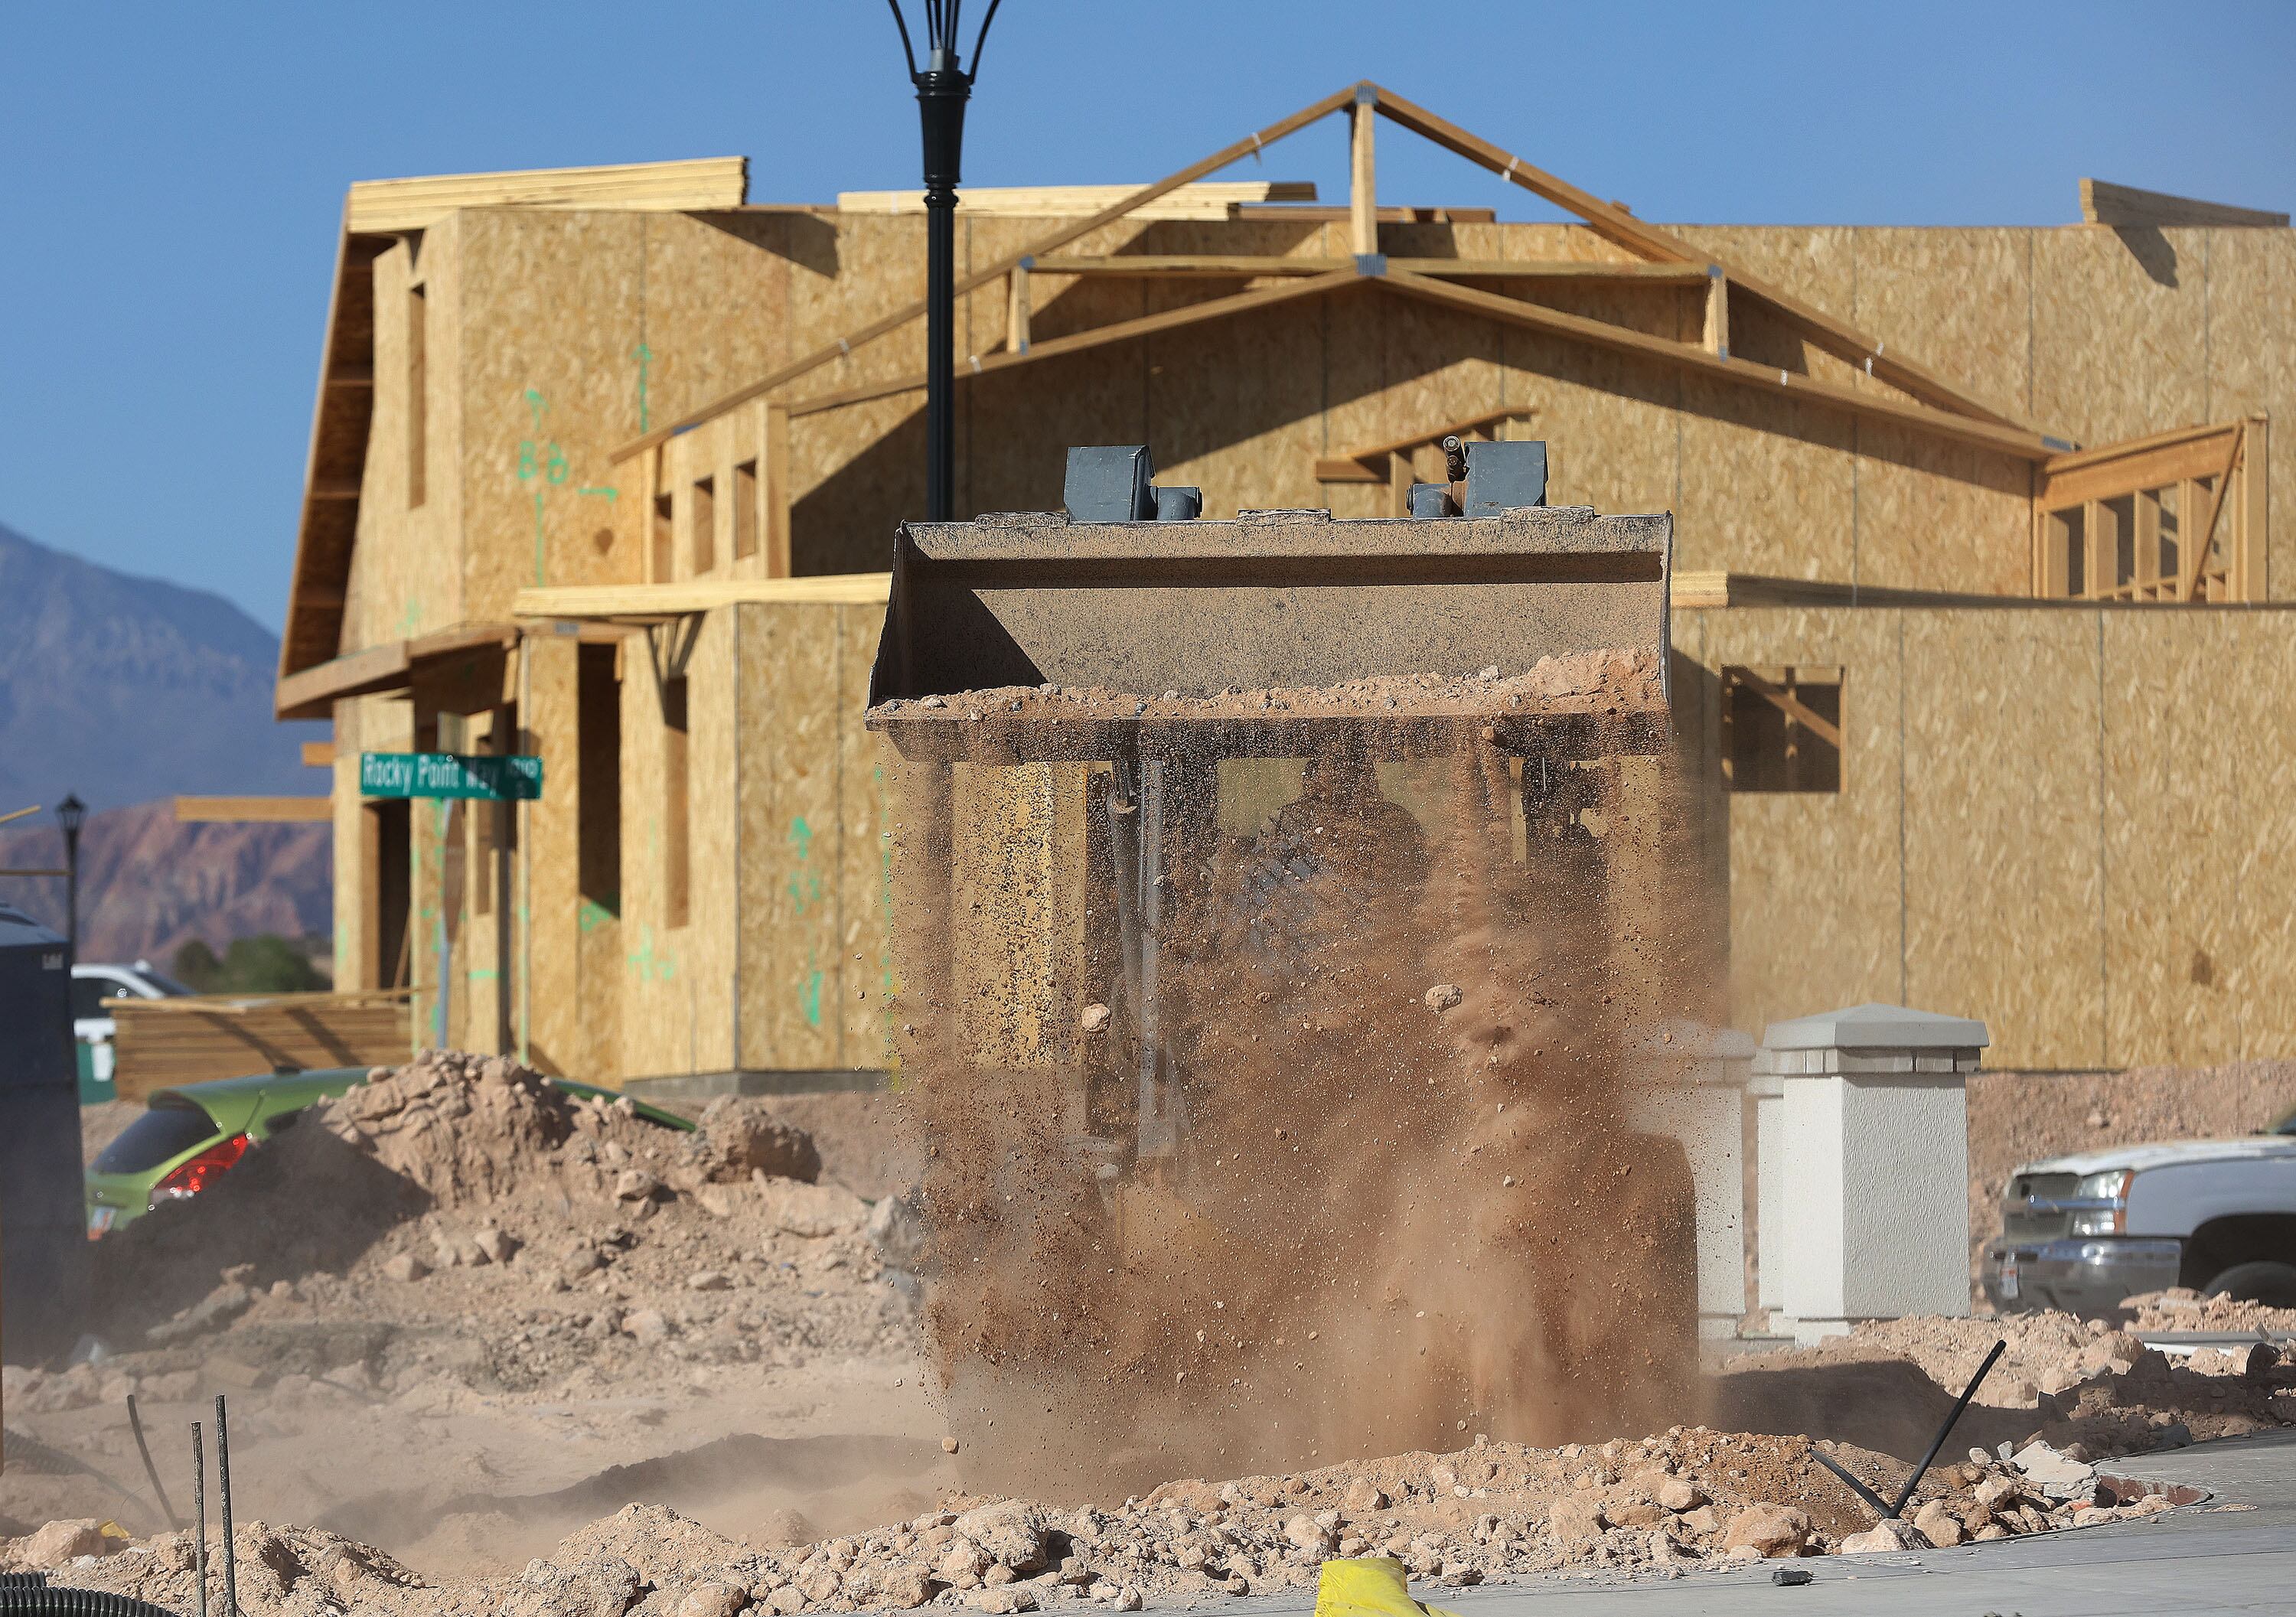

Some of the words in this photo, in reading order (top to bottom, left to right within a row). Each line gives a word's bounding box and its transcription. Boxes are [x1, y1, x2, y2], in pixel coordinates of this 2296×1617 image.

[364, 754, 413, 795] Rocky
[417, 754, 460, 789] Point
[465, 758, 501, 797] Way
